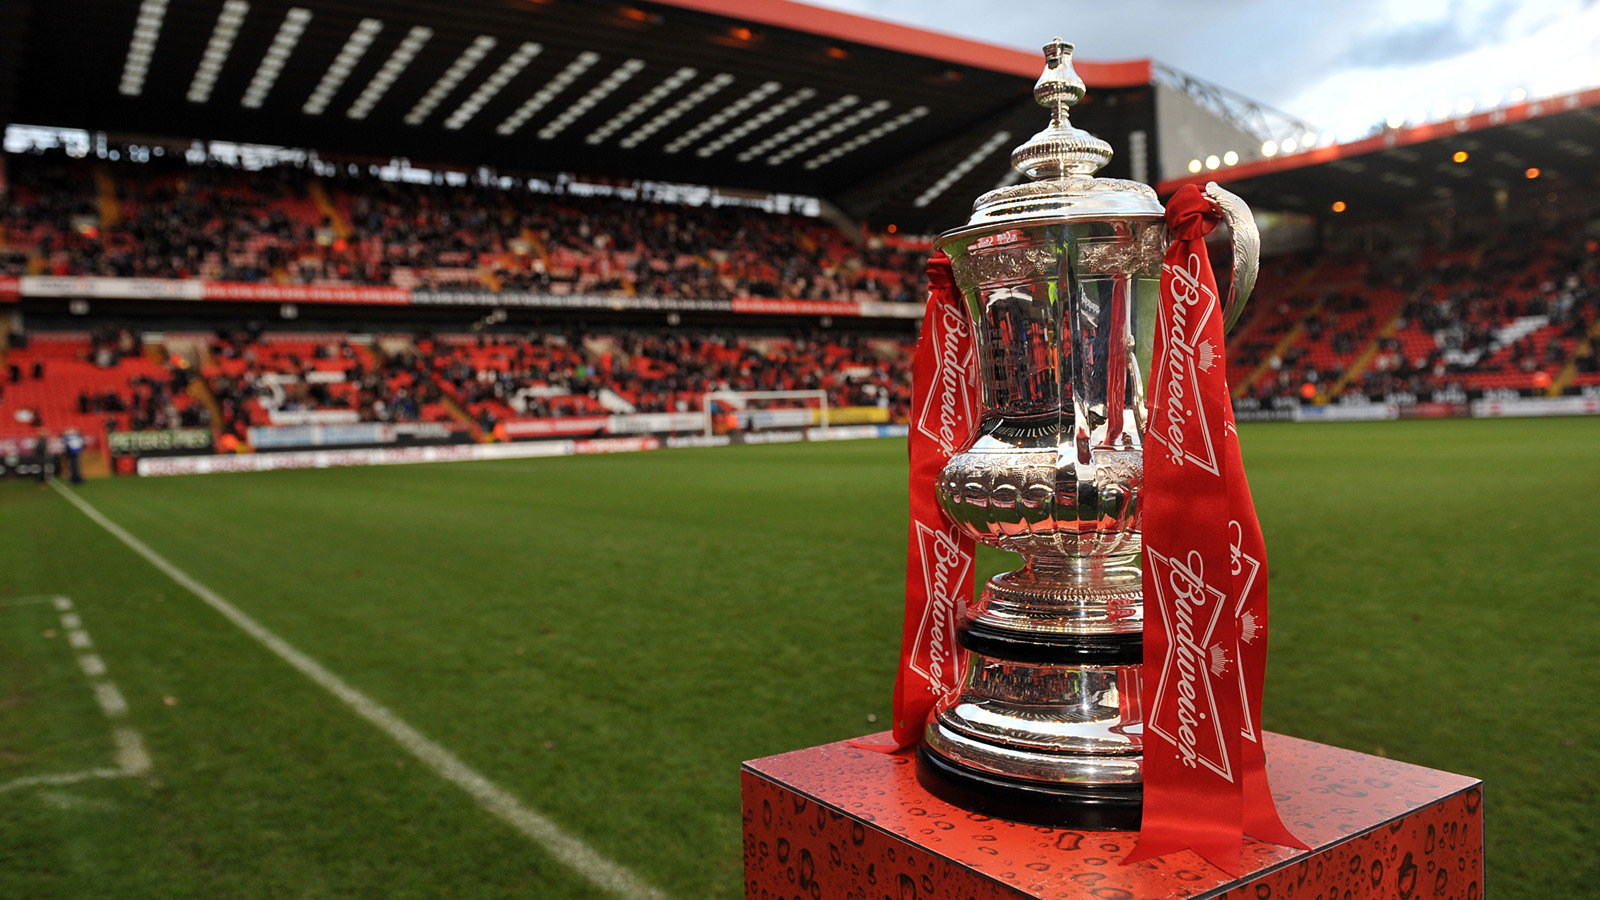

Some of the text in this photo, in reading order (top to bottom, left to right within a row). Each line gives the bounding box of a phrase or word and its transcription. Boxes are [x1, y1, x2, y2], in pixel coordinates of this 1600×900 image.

[936, 297, 970, 458] Budweiser
[1165, 253, 1200, 466] Budweiser
[927, 524, 961, 696] Budweiser
[1169, 549, 1206, 770] Budweiser
